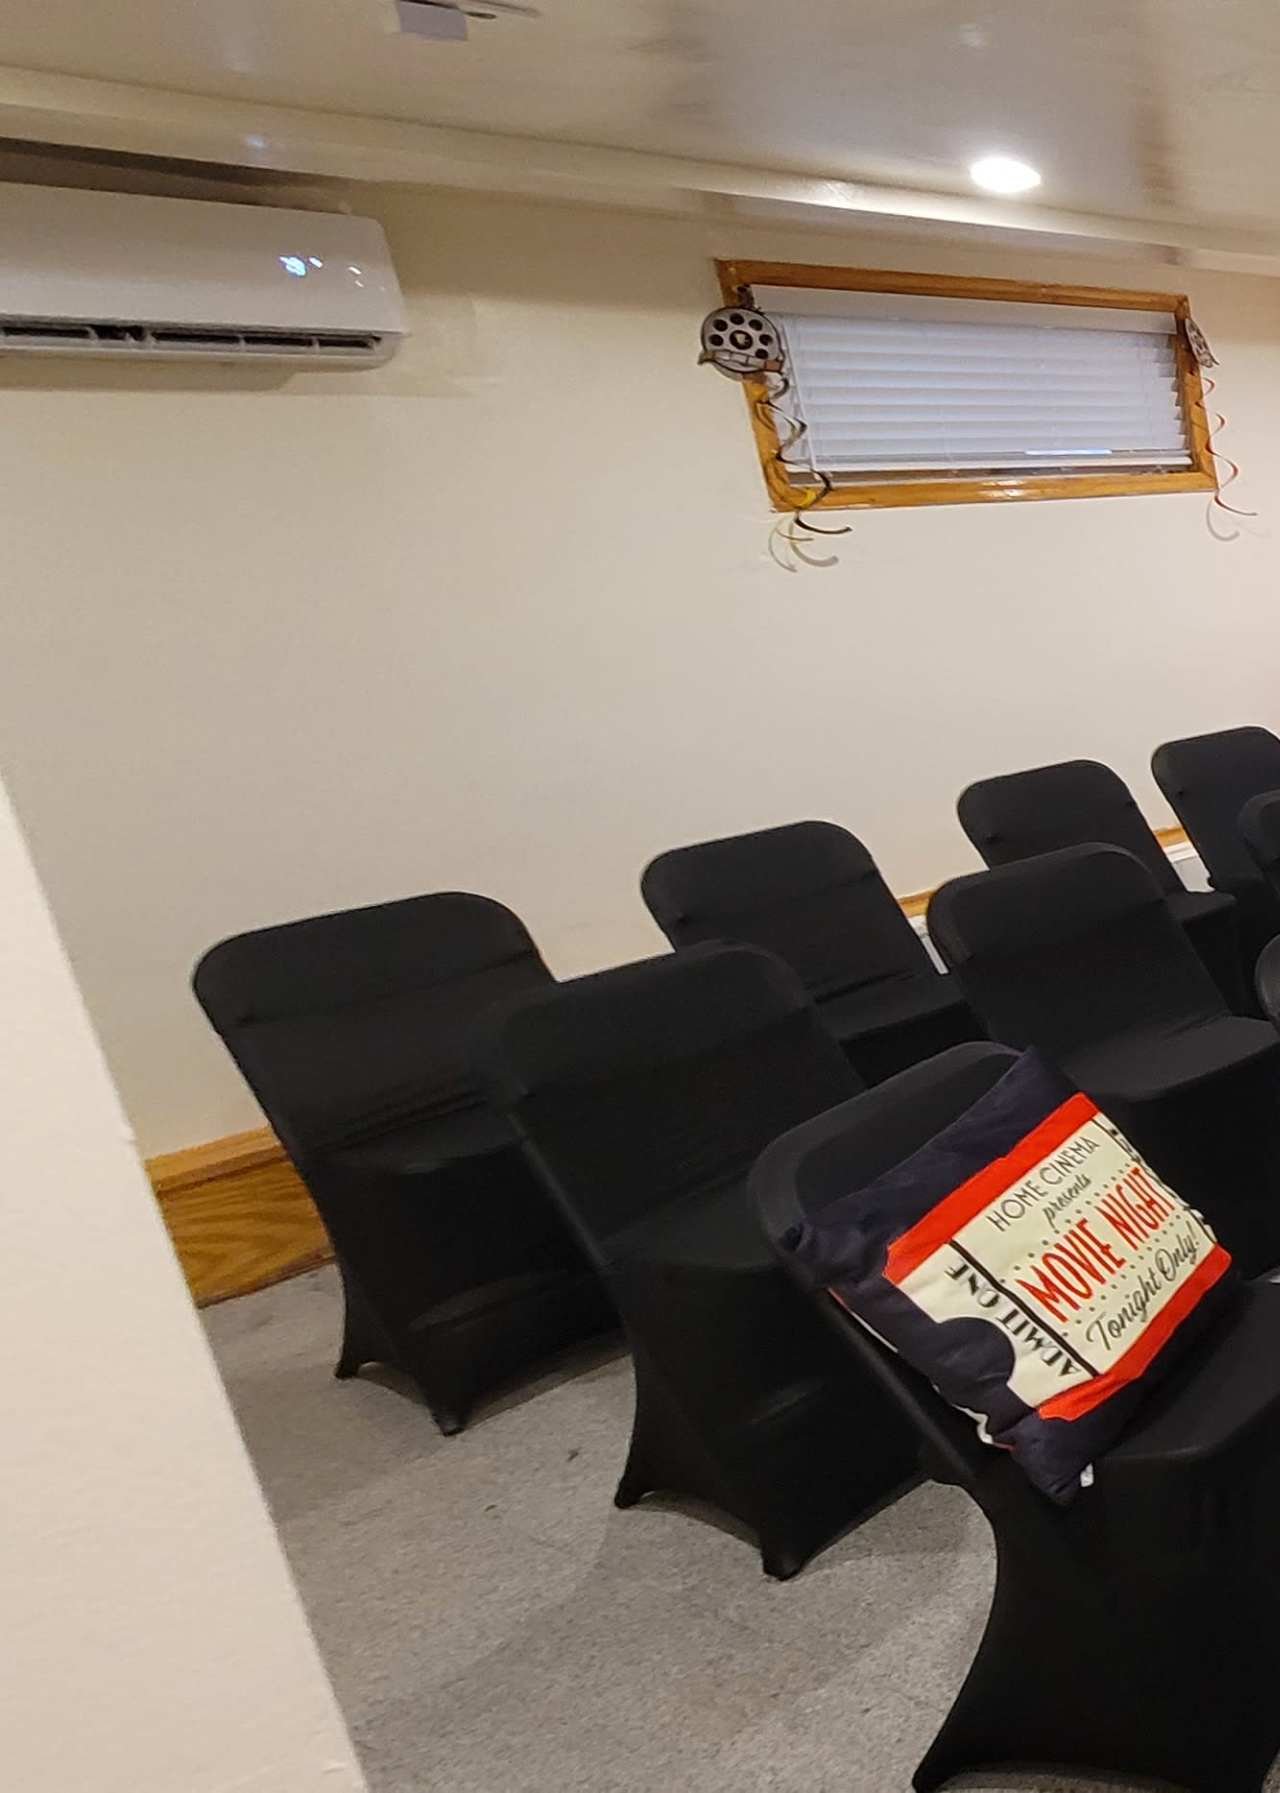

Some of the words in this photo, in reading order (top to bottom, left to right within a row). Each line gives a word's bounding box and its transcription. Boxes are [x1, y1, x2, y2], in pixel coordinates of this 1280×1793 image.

[988, 1178, 1043, 1233] HOME
[1039, 1135, 1101, 1190] CINEMA
[1043, 1172, 1093, 1231] presents
[944, 1262, 1000, 1308] ONE
[1016, 1217, 1127, 1323] MOVIE
[1094, 1166, 1176, 1252] NIGHT
[1086, 1272, 1163, 1352] Tonight
[1155, 1224, 1203, 1282] Only!
[995, 1308, 1082, 1377] ADMIT
